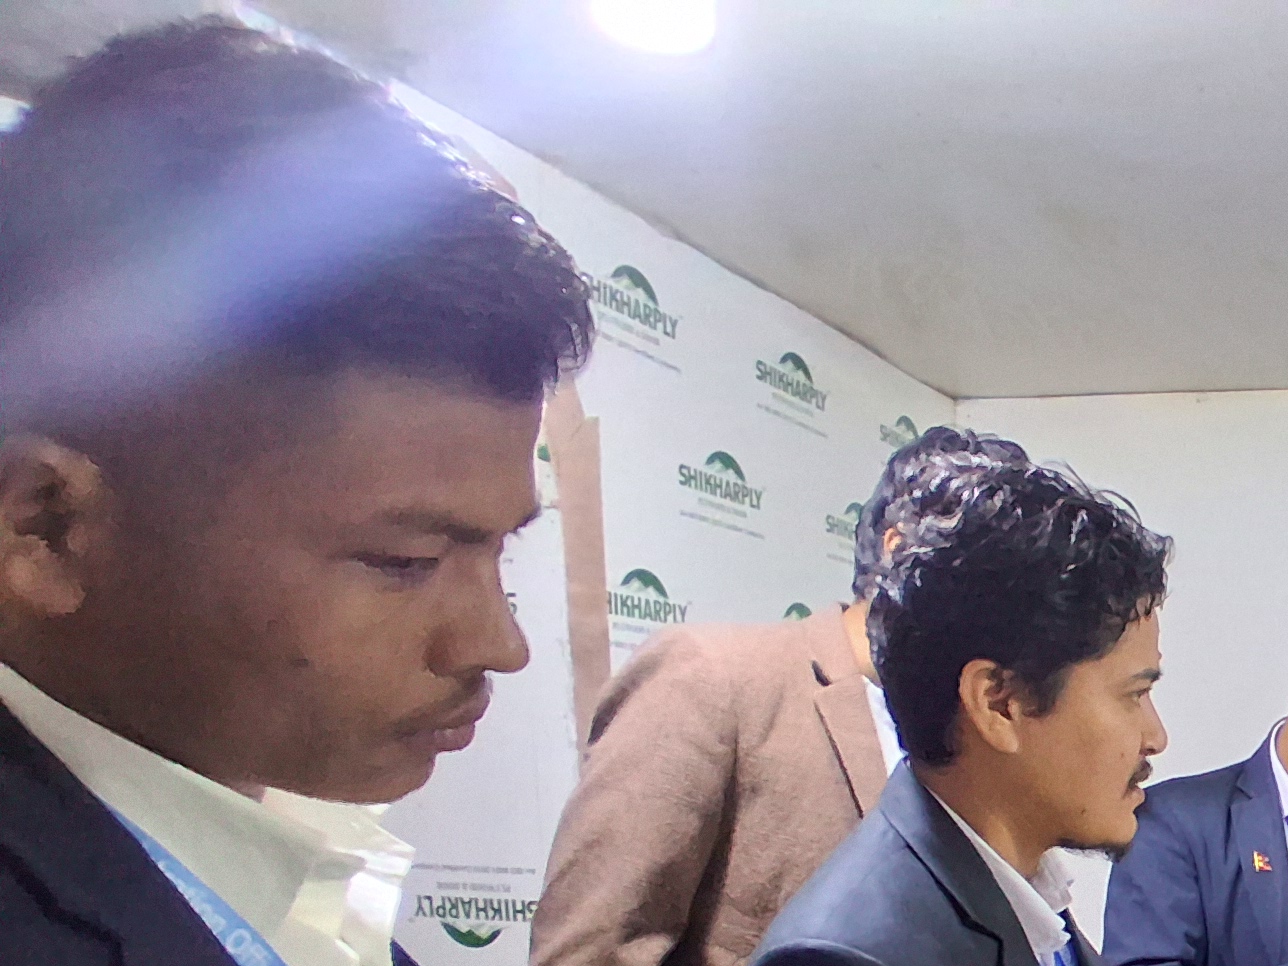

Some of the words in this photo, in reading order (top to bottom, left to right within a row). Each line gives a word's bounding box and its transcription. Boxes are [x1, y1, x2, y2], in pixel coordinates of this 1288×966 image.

[588, 279, 679, 340] HIKHARPLY
[755, 359, 827, 412] SHIKHARPLY
[678, 463, 763, 510] SHIKHARPLY
[607, 591, 687, 624] HIKHARPLY
